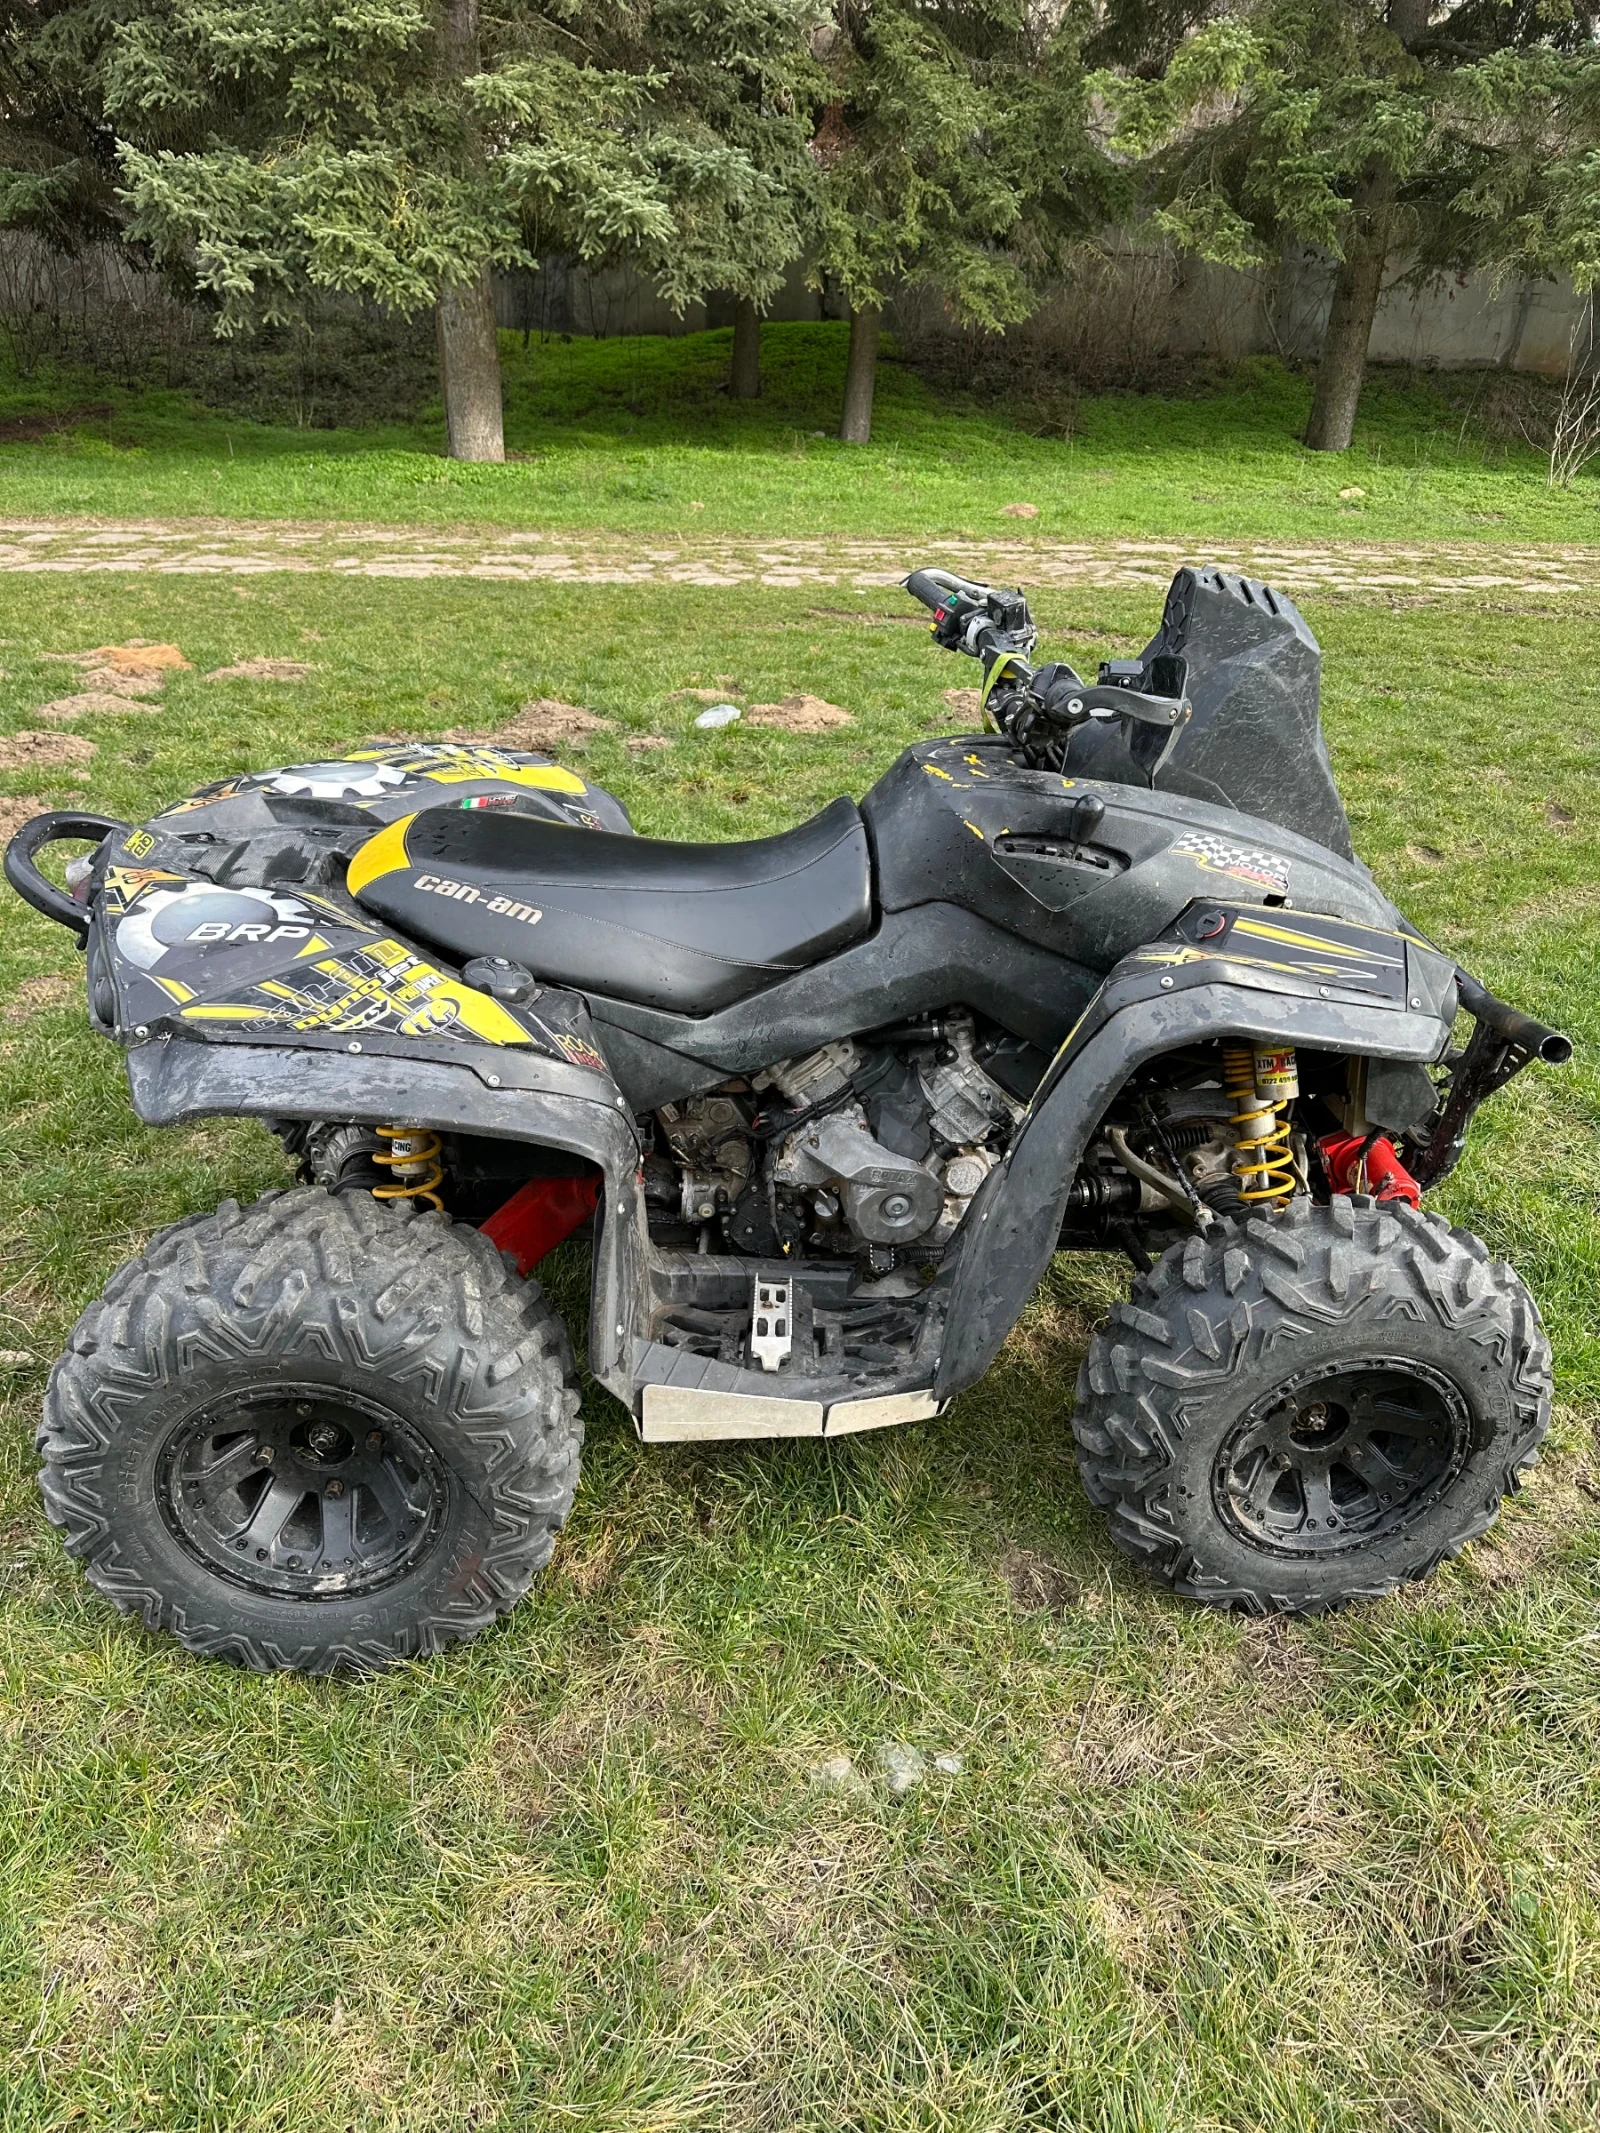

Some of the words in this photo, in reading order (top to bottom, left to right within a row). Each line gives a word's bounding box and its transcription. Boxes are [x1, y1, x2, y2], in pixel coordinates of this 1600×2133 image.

[1227, 857, 1287, 882] MOTOR
[413, 874, 543, 925] can-am
[184, 922, 310, 943] BRP
[400, 999, 451, 1036] ITP
[1257, 1058, 1275, 1069] XTM
[117, 1379, 213, 1505] BIGHORN
